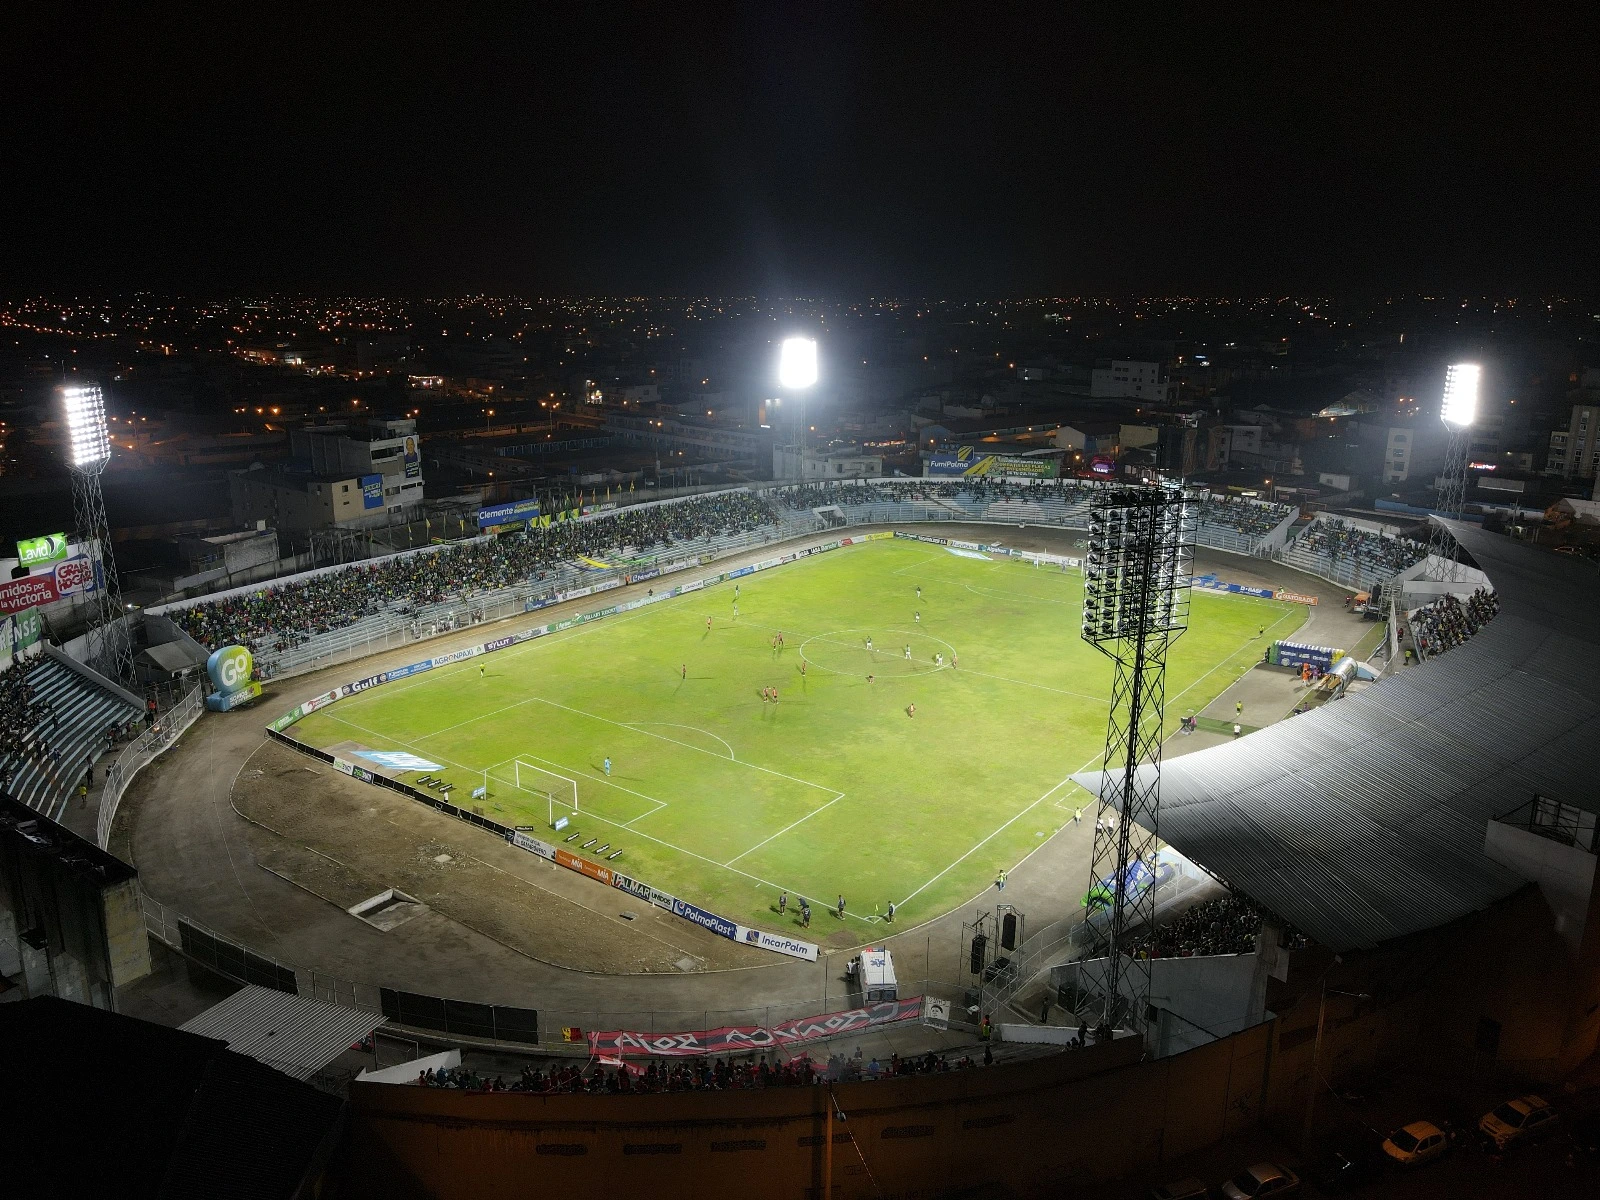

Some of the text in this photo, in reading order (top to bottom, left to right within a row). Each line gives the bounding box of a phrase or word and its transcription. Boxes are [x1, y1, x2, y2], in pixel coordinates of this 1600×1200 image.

[930, 460, 969, 469] FumiPalma
[479, 507, 514, 520] Clemente
[57, 561, 89, 579] GRAN
[33, 582, 45, 592] por
[9, 588, 52, 609] victoria
[488, 638, 510, 650] SYLLIT
[221, 654, 248, 686] GO
[352, 676, 378, 693] Gulf
[615, 873, 650, 897] PALMAR
[651, 891, 671, 906] UNIDOS
[684, 906, 732, 936] PalmaPlast
[761, 935, 808, 955] IncarPalm
